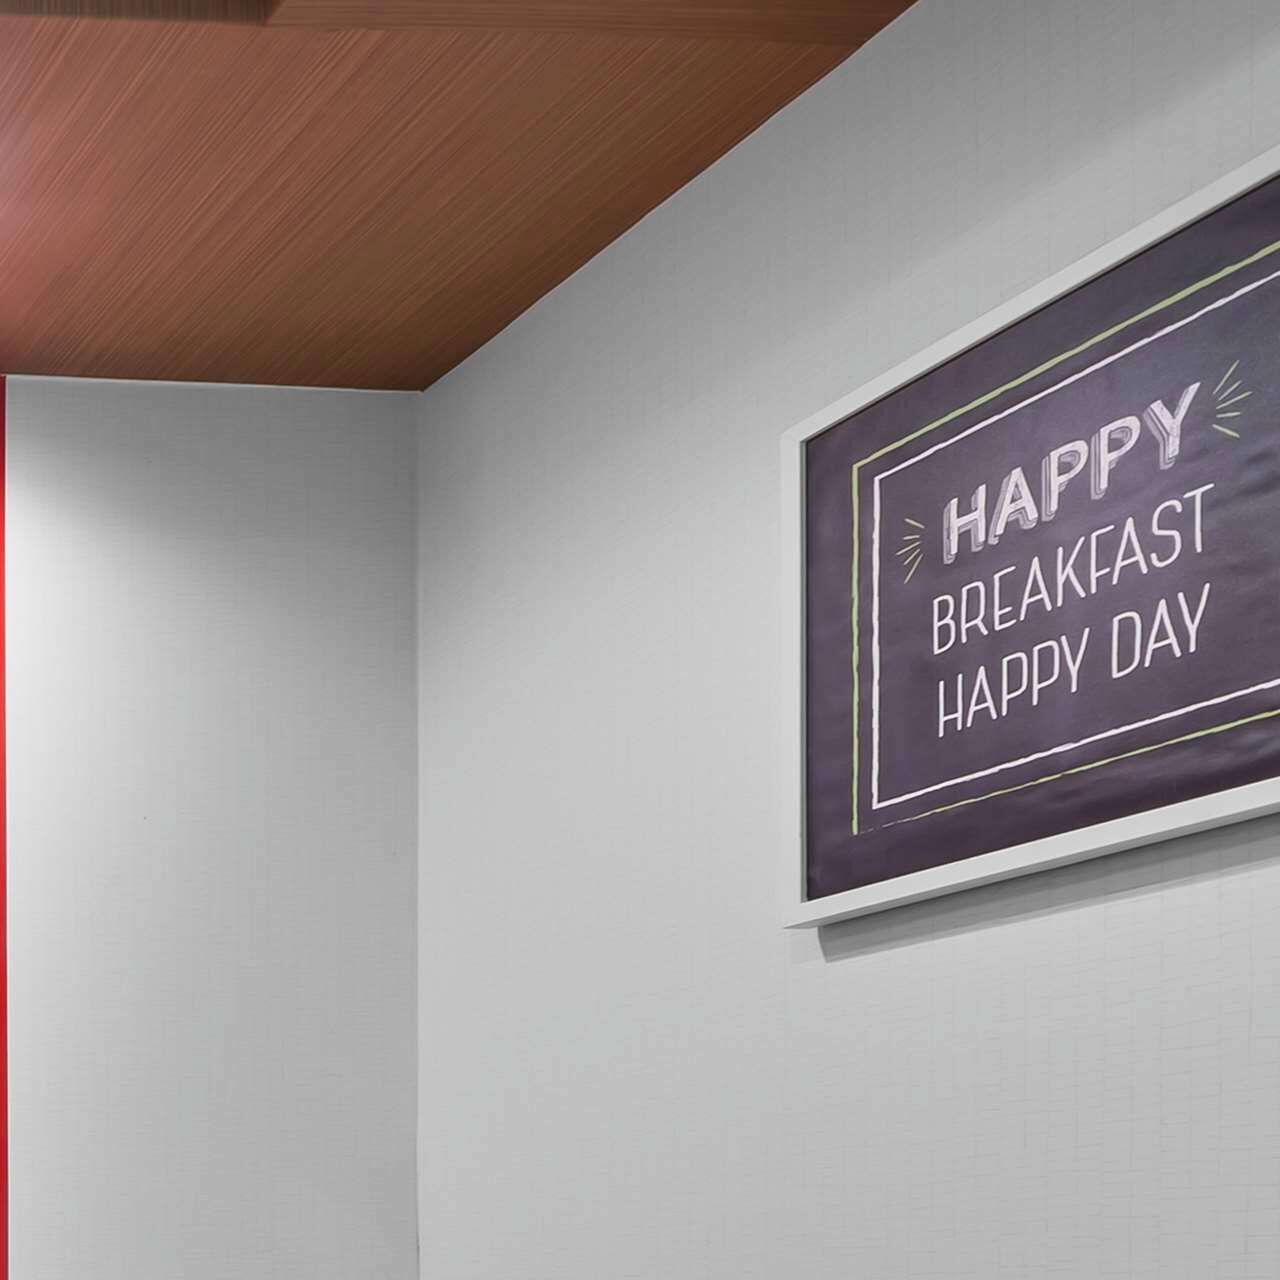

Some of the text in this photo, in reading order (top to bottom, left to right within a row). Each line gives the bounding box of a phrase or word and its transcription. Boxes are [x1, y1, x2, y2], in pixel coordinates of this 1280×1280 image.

[943, 382, 1201, 565] HAPPY
[933, 483, 1214, 655] BREAKFAST
[938, 583, 1211, 738] HAPPY DAY
